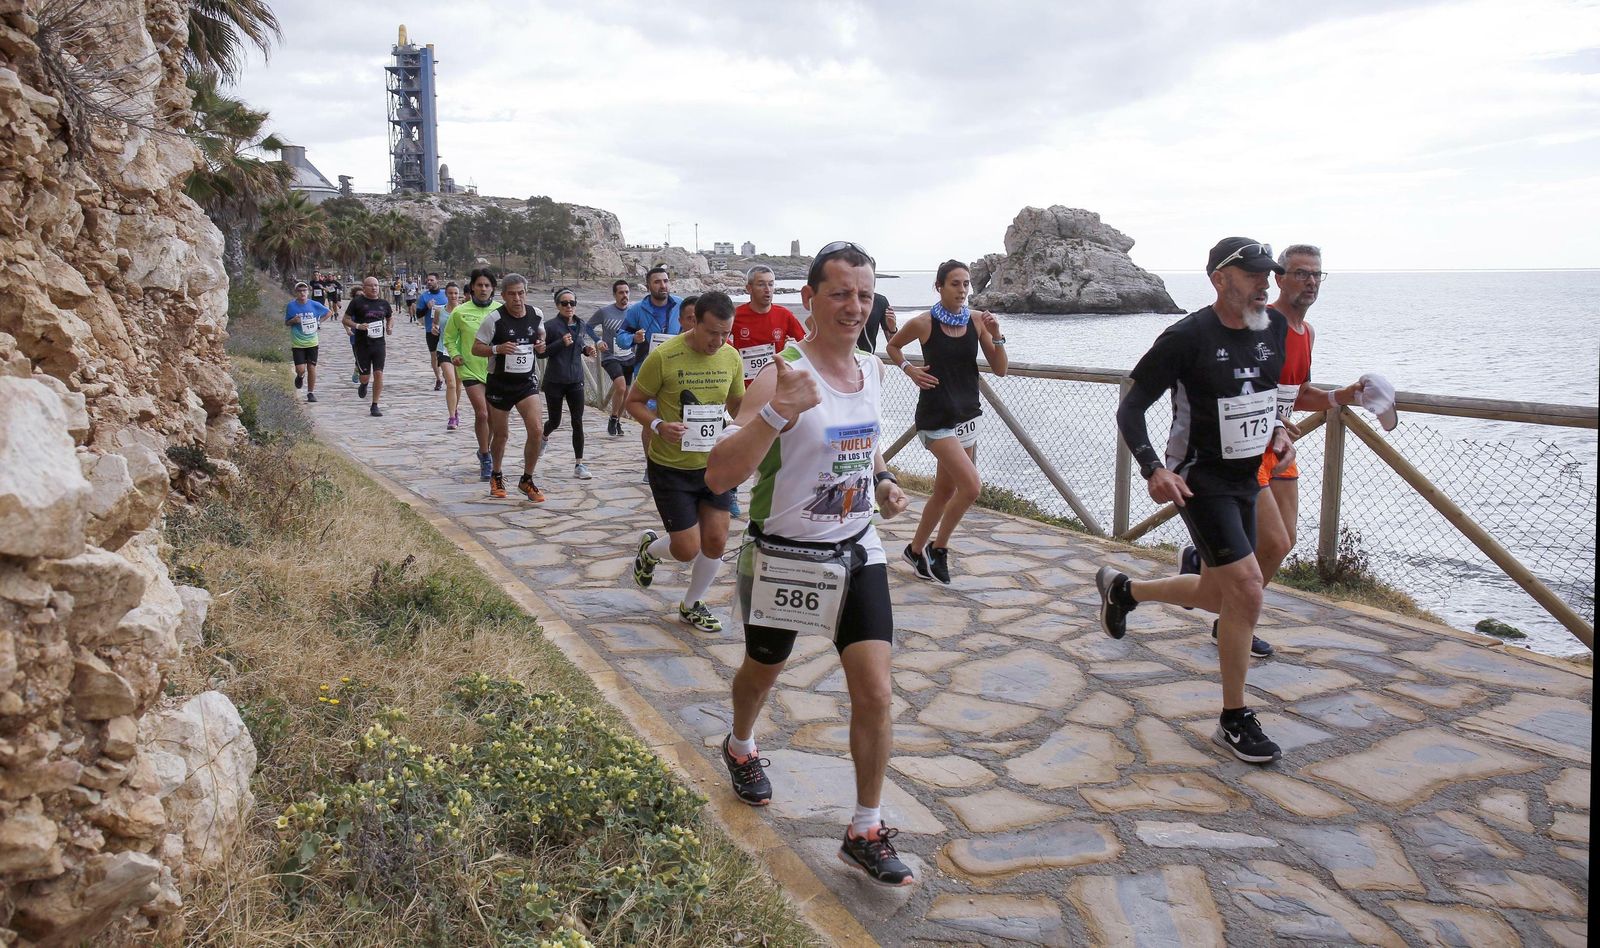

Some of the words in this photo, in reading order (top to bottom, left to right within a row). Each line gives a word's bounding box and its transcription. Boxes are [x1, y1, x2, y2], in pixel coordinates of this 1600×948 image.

[516, 356, 527, 364] 53
[700, 424, 715, 438] 63
[957, 421, 976, 436] 510
[1240, 417, 1268, 438] 173
[841, 437, 872, 451] VUELA
[838, 453, 847, 461] EN
[848, 452, 860, 461] LOS
[774, 588, 819, 610] 586
[793, 619, 814, 627] POPULAR
